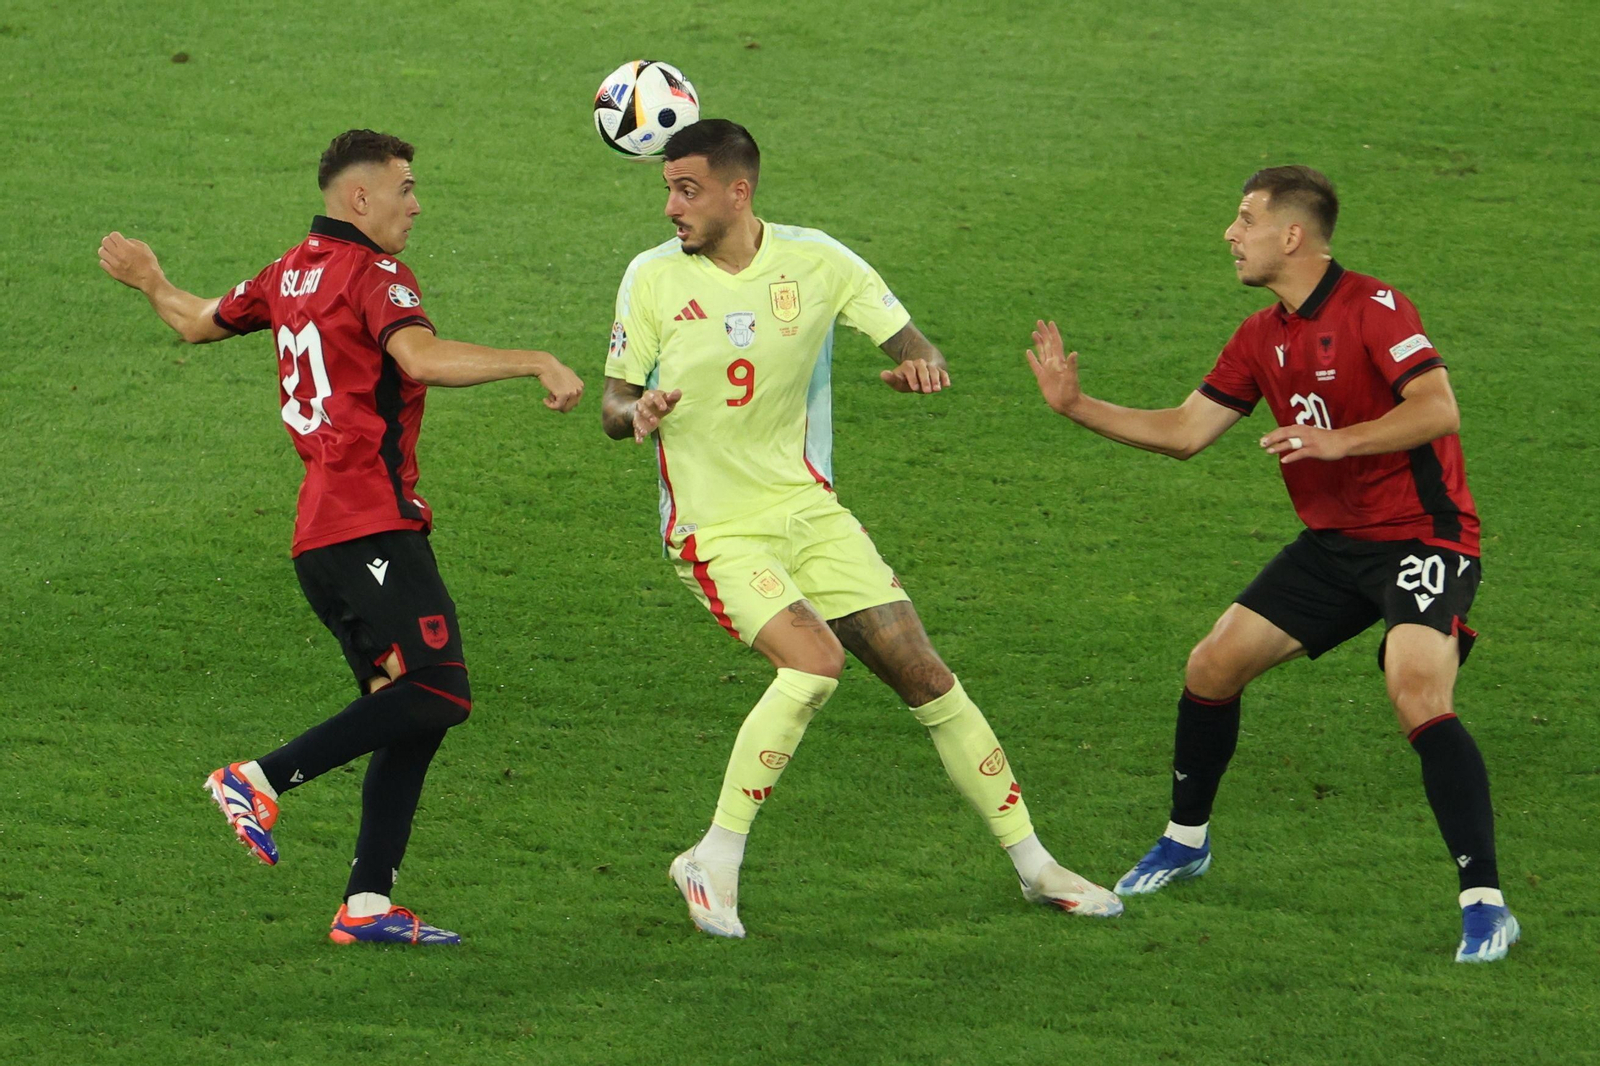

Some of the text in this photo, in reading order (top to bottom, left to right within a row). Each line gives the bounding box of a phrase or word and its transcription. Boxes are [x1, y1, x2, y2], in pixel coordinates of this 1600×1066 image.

[726, 358, 755, 407] 9
[1289, 392, 1332, 430] 20
[1396, 554, 1446, 595] 20
